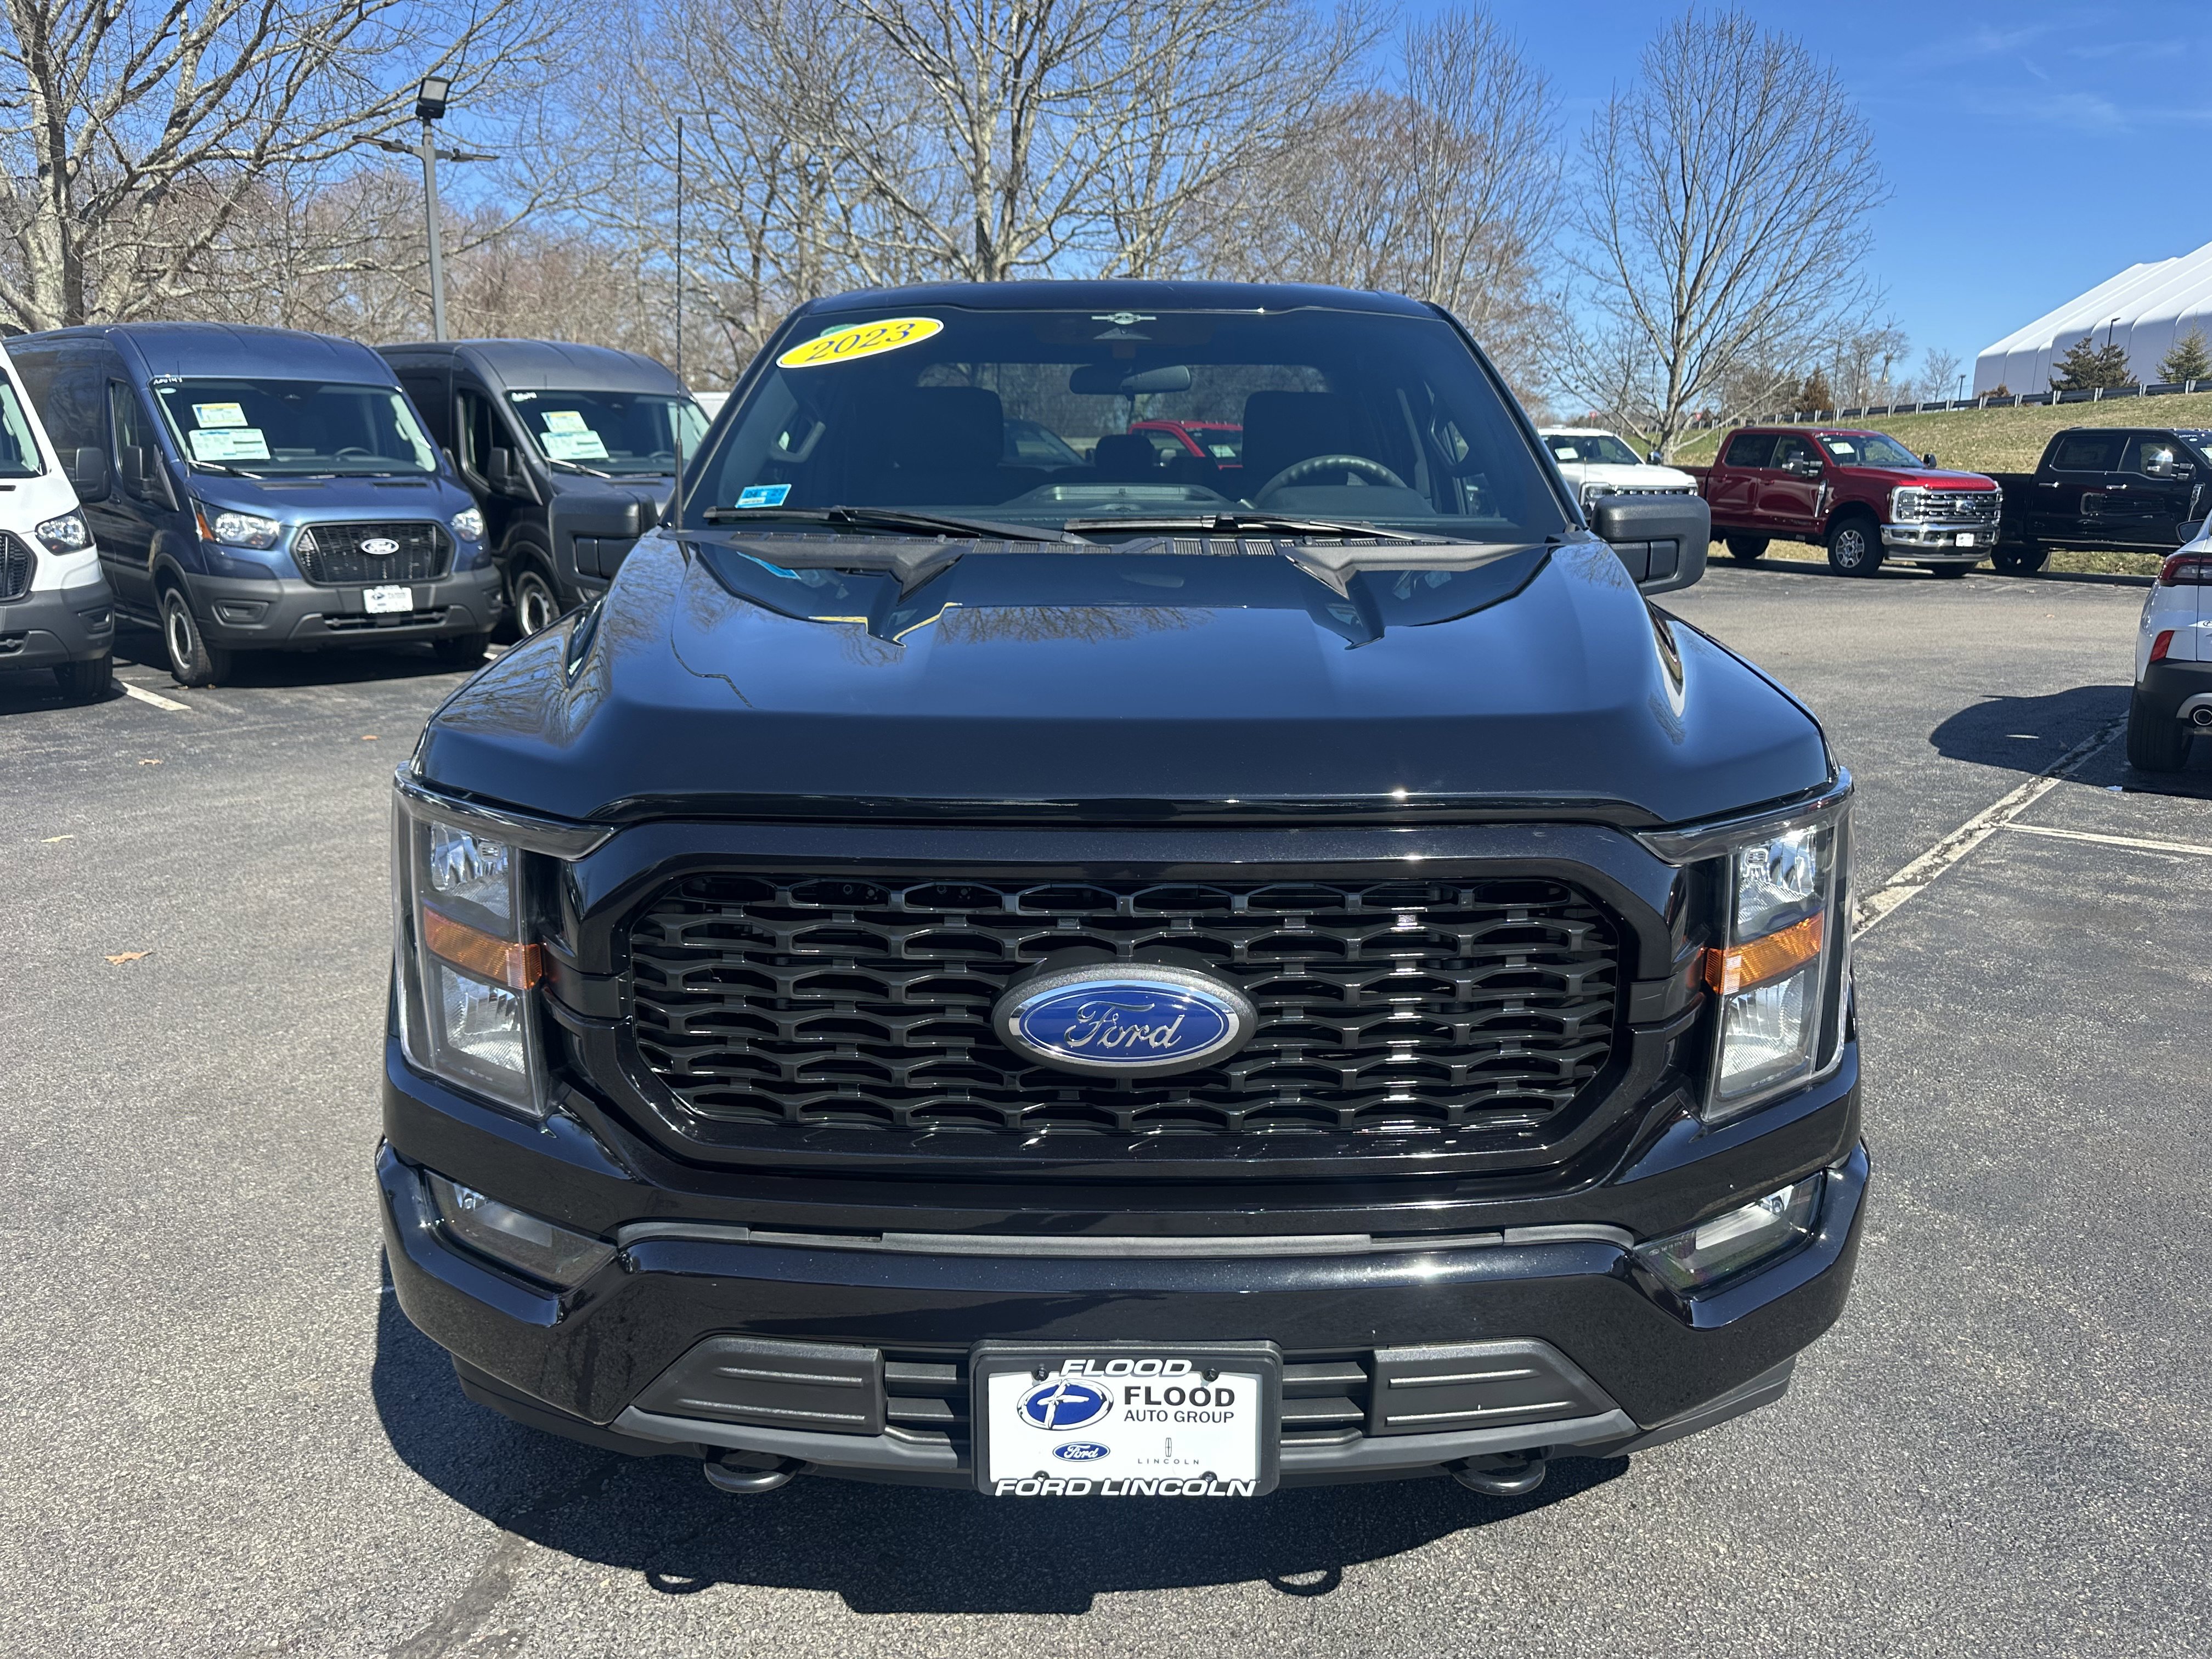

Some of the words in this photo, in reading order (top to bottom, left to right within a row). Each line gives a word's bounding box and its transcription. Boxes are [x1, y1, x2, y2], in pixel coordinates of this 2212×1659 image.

[804, 323, 915, 362] 2023
[1064, 1001, 1184, 1047] Ford
[1060, 1359, 1193, 1377] FLOOD
[1124, 1386, 1235, 1407] FLOOD
[1124, 1410, 1169, 1423] AUTO
[1174, 1411, 1234, 1424] GROUP
[1064, 1444, 1099, 1458] Ford
[995, 1479, 1093, 1497] FORD
[1099, 1479, 1257, 1497] LINCOLN
